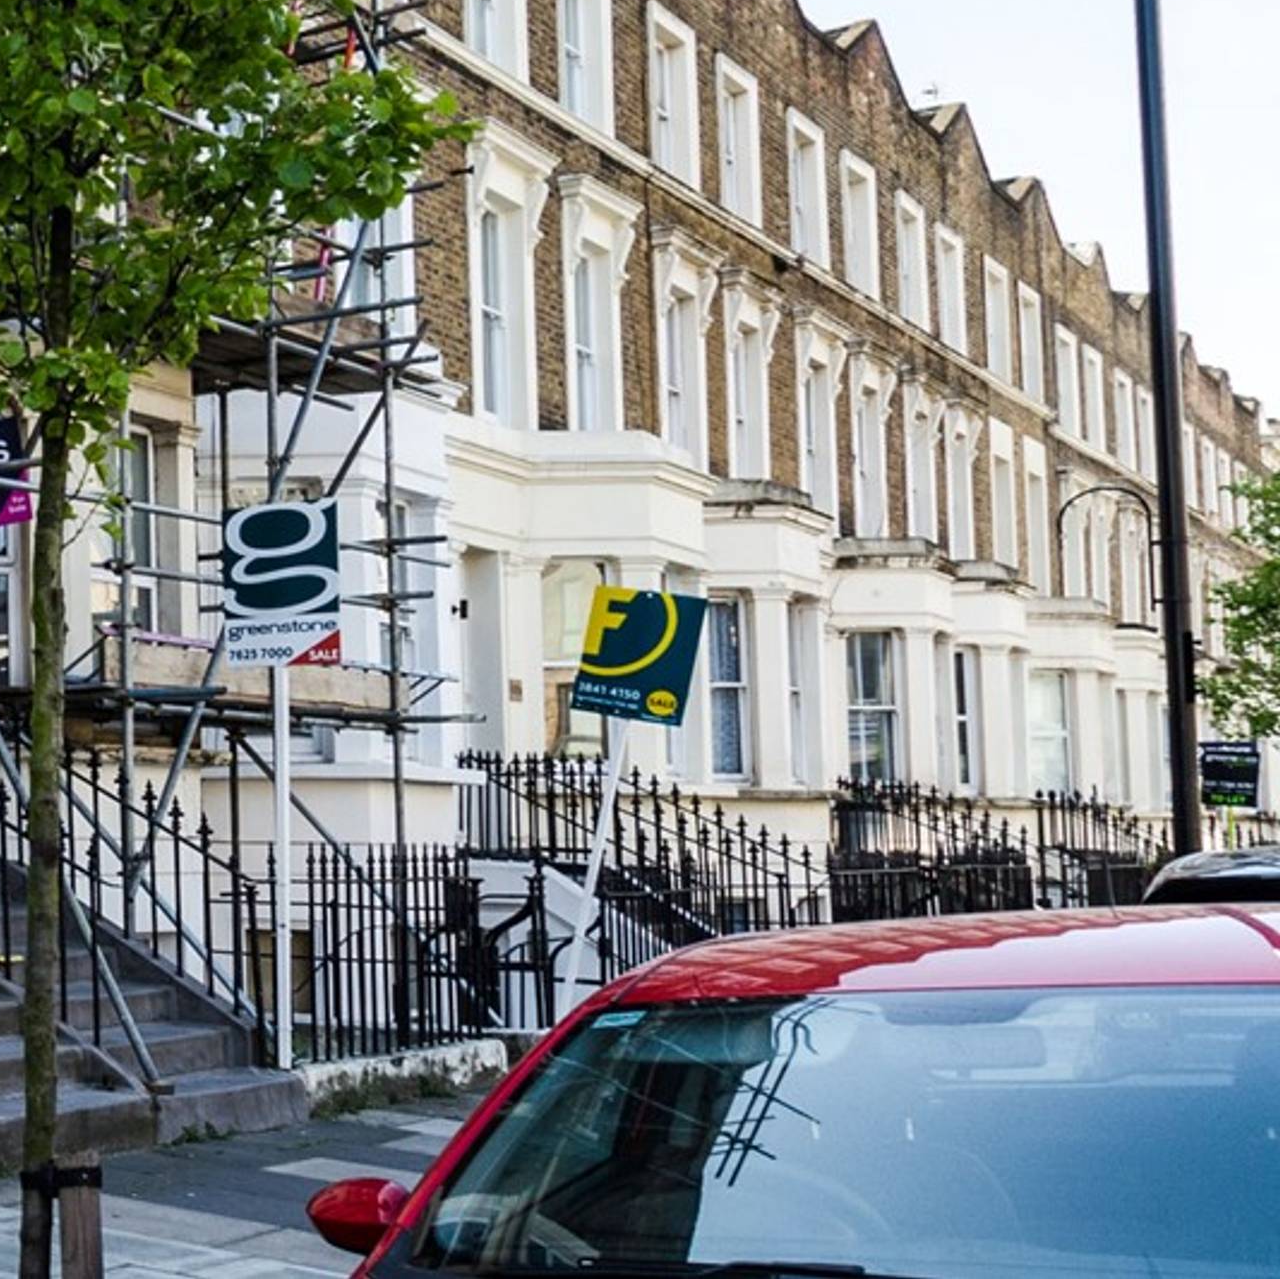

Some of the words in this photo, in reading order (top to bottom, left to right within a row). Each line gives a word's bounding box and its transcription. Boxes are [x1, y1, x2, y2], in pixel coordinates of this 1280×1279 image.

[228, 620, 337, 642] greenstone
[261, 647, 293, 659] 7000
[309, 648, 338, 661] SALE
[649, 698, 676, 709] SALE
